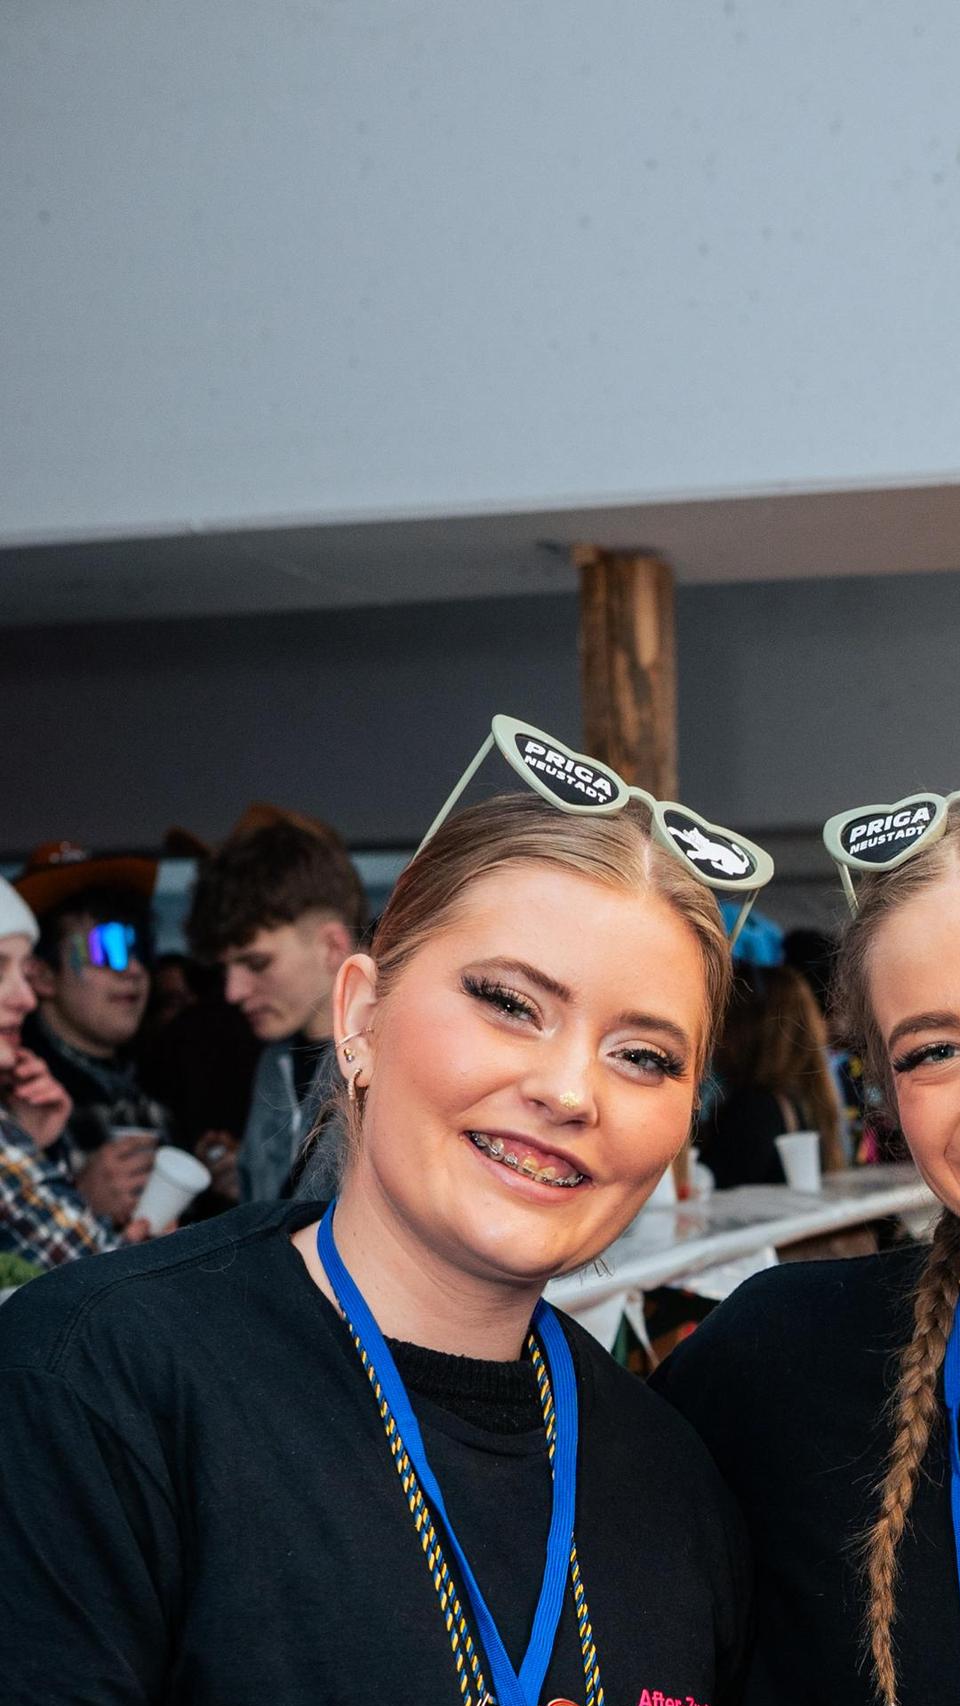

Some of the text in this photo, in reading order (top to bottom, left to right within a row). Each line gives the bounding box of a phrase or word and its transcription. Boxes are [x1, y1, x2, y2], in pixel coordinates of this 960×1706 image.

[525, 741, 612, 797] PRIGA
[525, 755, 607, 803] NEUSTADT
[850, 807, 931, 843] PRIGA
[850, 824, 927, 854] NEUSTADT
